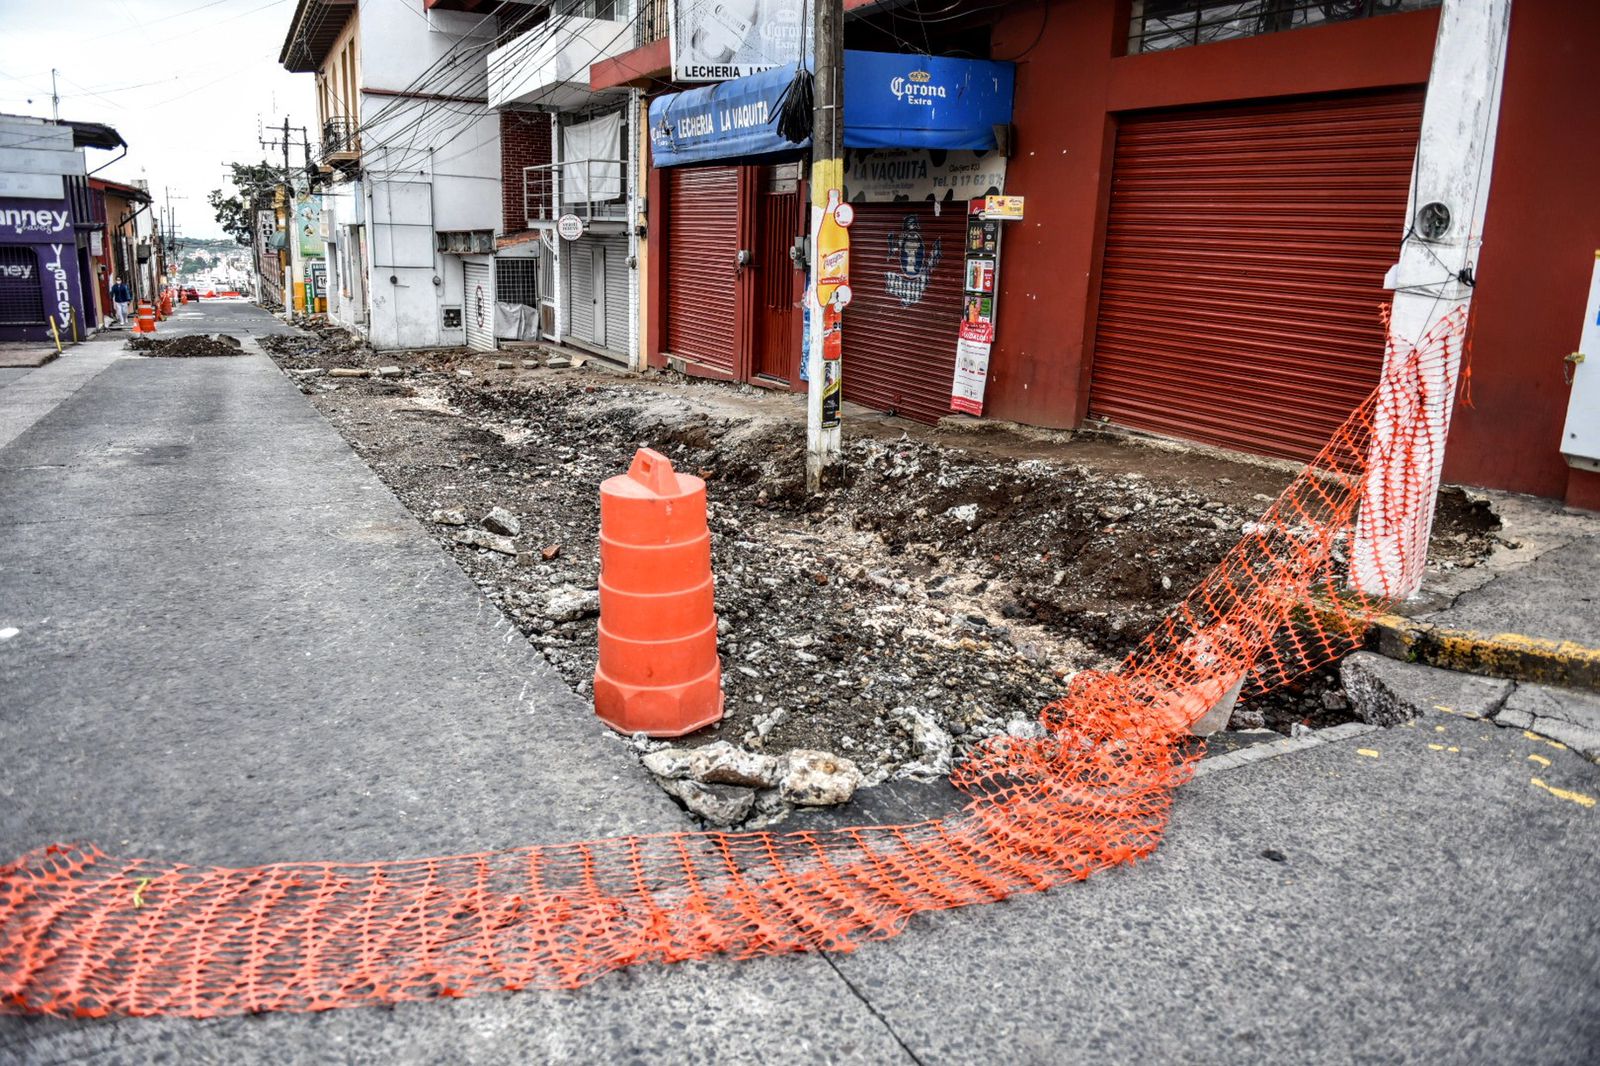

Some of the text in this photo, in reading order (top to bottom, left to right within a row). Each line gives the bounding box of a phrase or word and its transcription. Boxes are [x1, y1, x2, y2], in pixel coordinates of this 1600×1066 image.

[685, 66, 741, 78] LECHERIA
[890, 77, 947, 101] Corona
[908, 97, 932, 106] Extra
[678, 101, 769, 139] LECHERIA LA VAQUITA
[853, 159, 928, 182] LA VAQUITA
[960, 175, 971, 186] 17
[974, 174, 985, 185] 62
